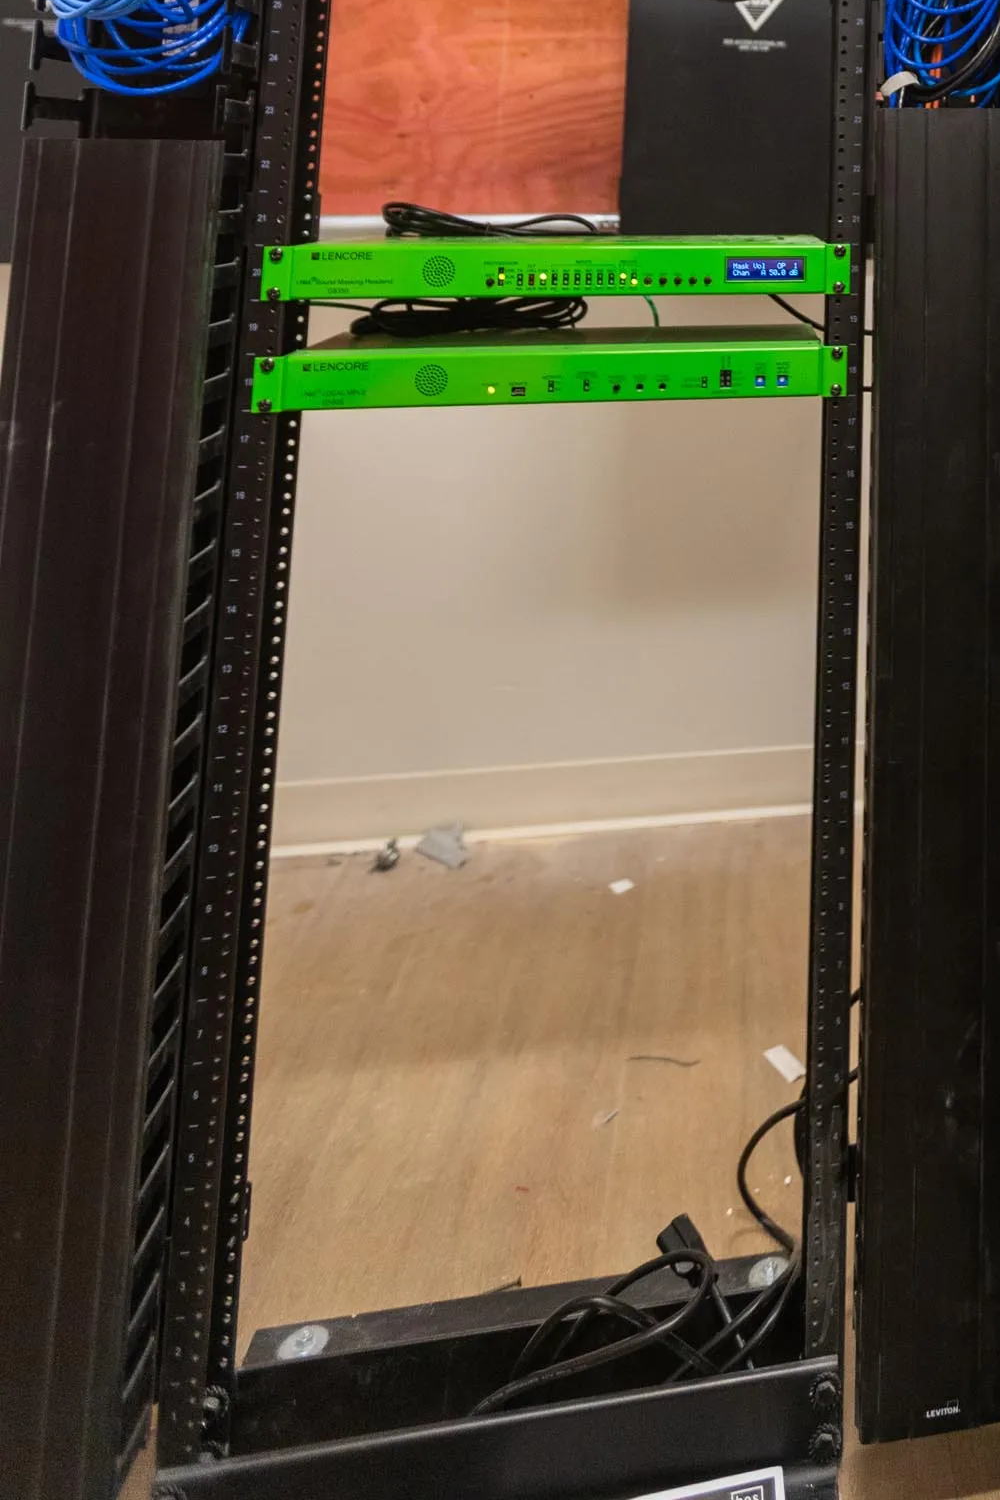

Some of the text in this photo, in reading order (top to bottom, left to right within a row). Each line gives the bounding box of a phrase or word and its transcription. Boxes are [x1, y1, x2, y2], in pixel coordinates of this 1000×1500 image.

[273, 1, 282, 9] 25
[269, 53, 278, 62] 24
[265, 106, 274, 114] 23
[261, 160, 270, 169] 22
[257, 214, 266, 222] 21
[321, 252, 373, 261] LENCORE
[732, 262, 750, 270] Mask
[752, 262, 766, 270] Vol
[249, 323, 258, 331] 19
[312, 361, 369, 372] LENCORE
[240, 435, 250, 443] 17
[236, 491, 245, 499] 16
[231, 548, 241, 557] 15
[226, 605, 237, 613] 14
[222, 664, 232, 673] 13
[217, 724, 228, 733] 12
[213, 784, 223, 792] 11
[208, 844, 219, 853] 10
[205, 904, 212, 913] 9
[201, 966, 207, 975] 8
[197, 1029, 204, 1038] 7
[192, 1090, 199, 1100] 6
[188, 1153, 194, 1163] 5
[184, 1217, 190, 1226] 4
[180, 1282, 186, 1292] 3
[175, 1346, 181, 1357] 2
[926, 1406, 960, 1419] LEVITON
